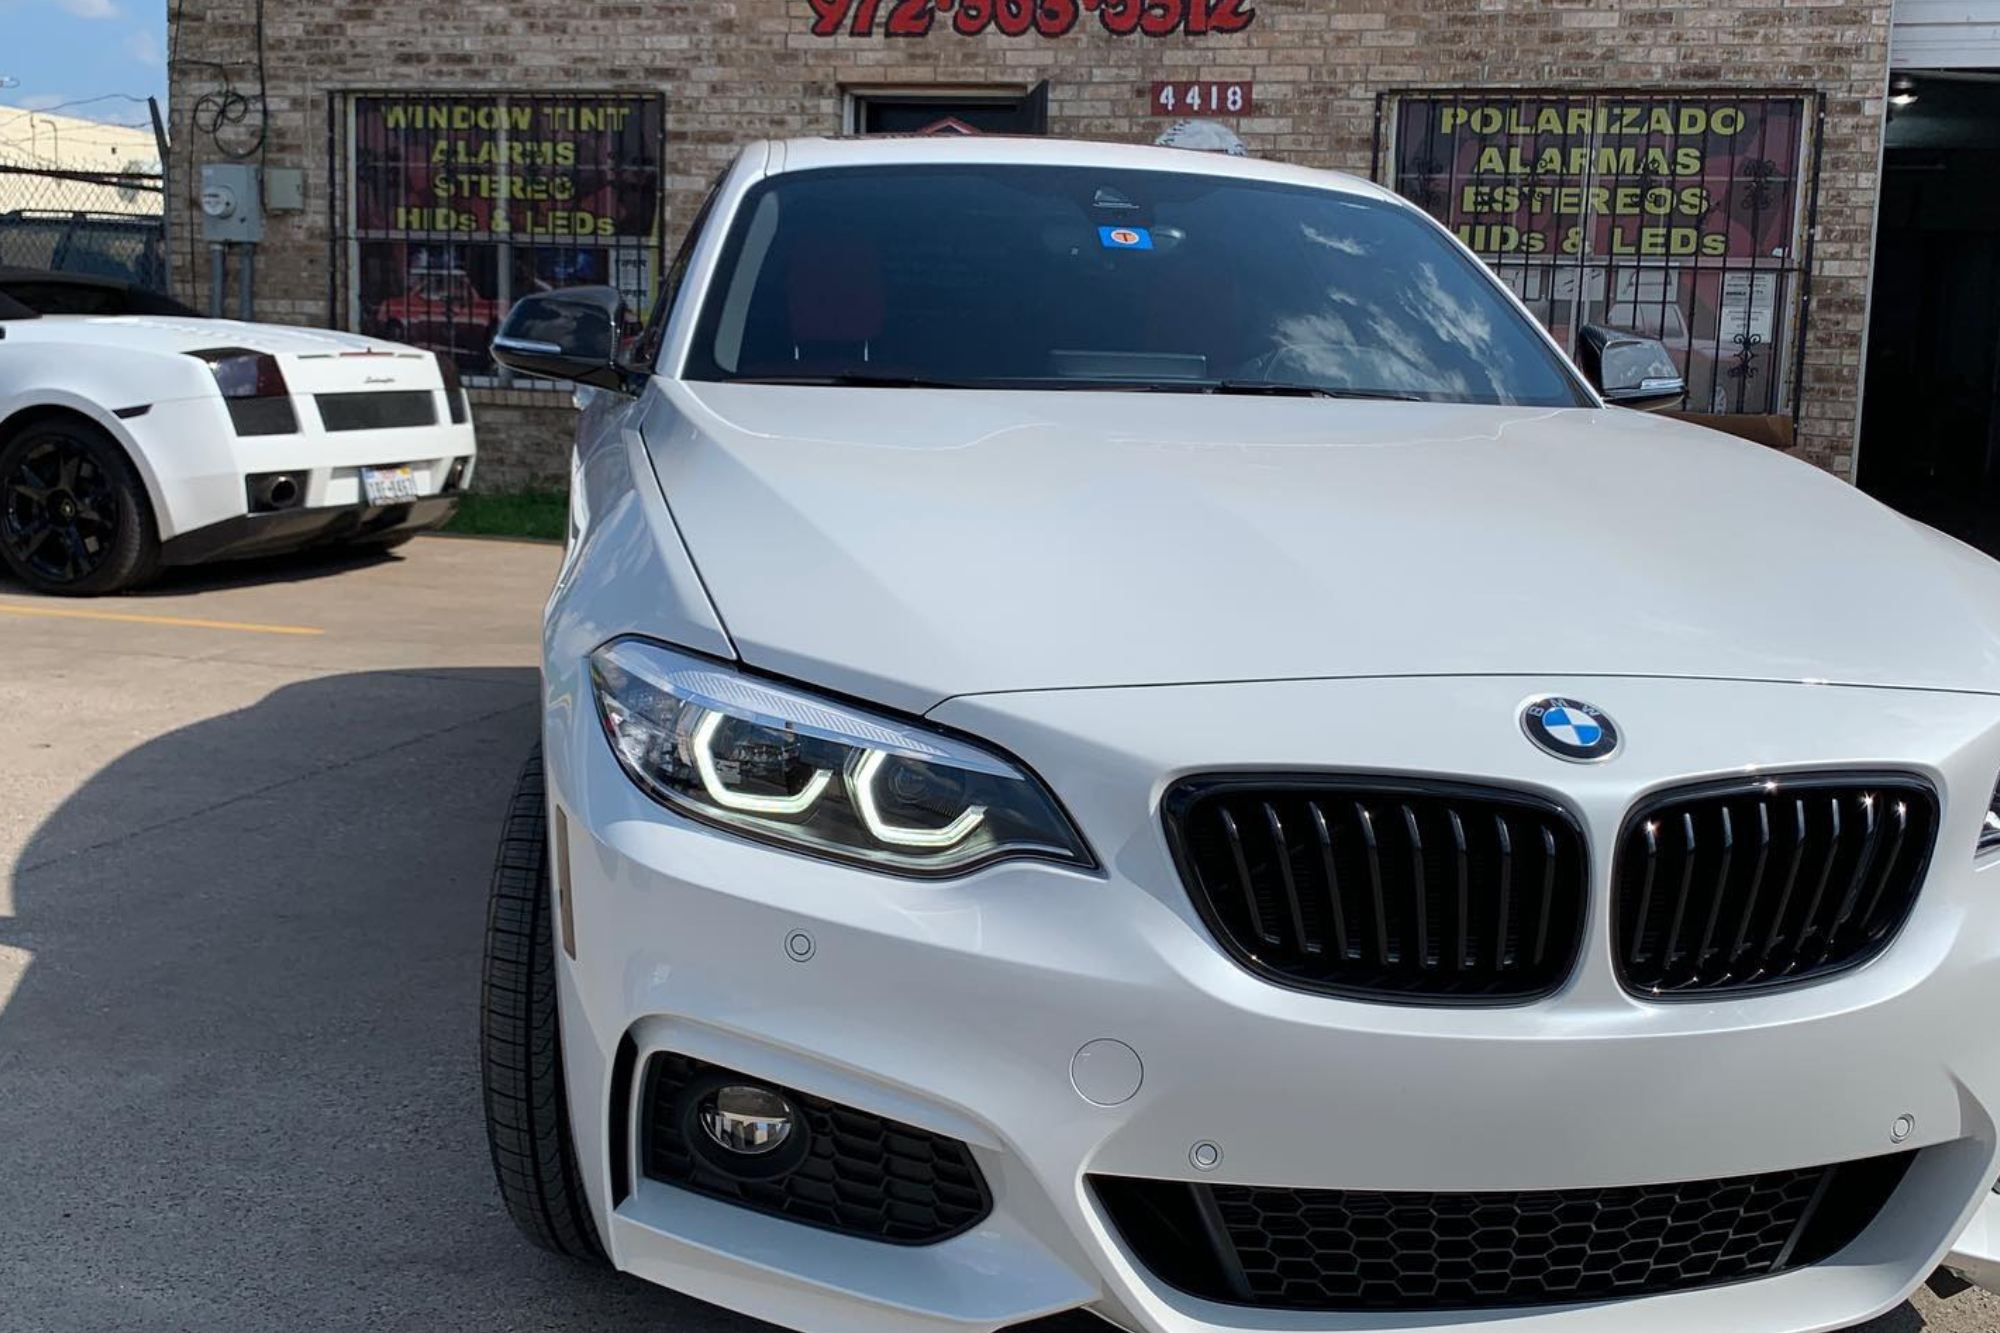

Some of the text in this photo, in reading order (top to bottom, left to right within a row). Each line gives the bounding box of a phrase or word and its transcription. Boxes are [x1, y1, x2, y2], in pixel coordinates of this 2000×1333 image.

[1159, 84, 1243, 112] 4418
[384, 105, 630, 130] WINDOW TINT
[1440, 107, 1745, 135] POLARIZADO
[431, 139, 575, 165] ALARMS
[1475, 147, 1701, 175] ALARMAS
[433, 174, 575, 199] STEREO
[1462, 186, 1708, 215] ESTEREOS
[396, 207, 615, 235] HIDs & LEDs
[1562, 226, 1591, 253] &
[1613, 228, 1726, 255] LEDs
[1528, 698, 1601, 718] BMW
